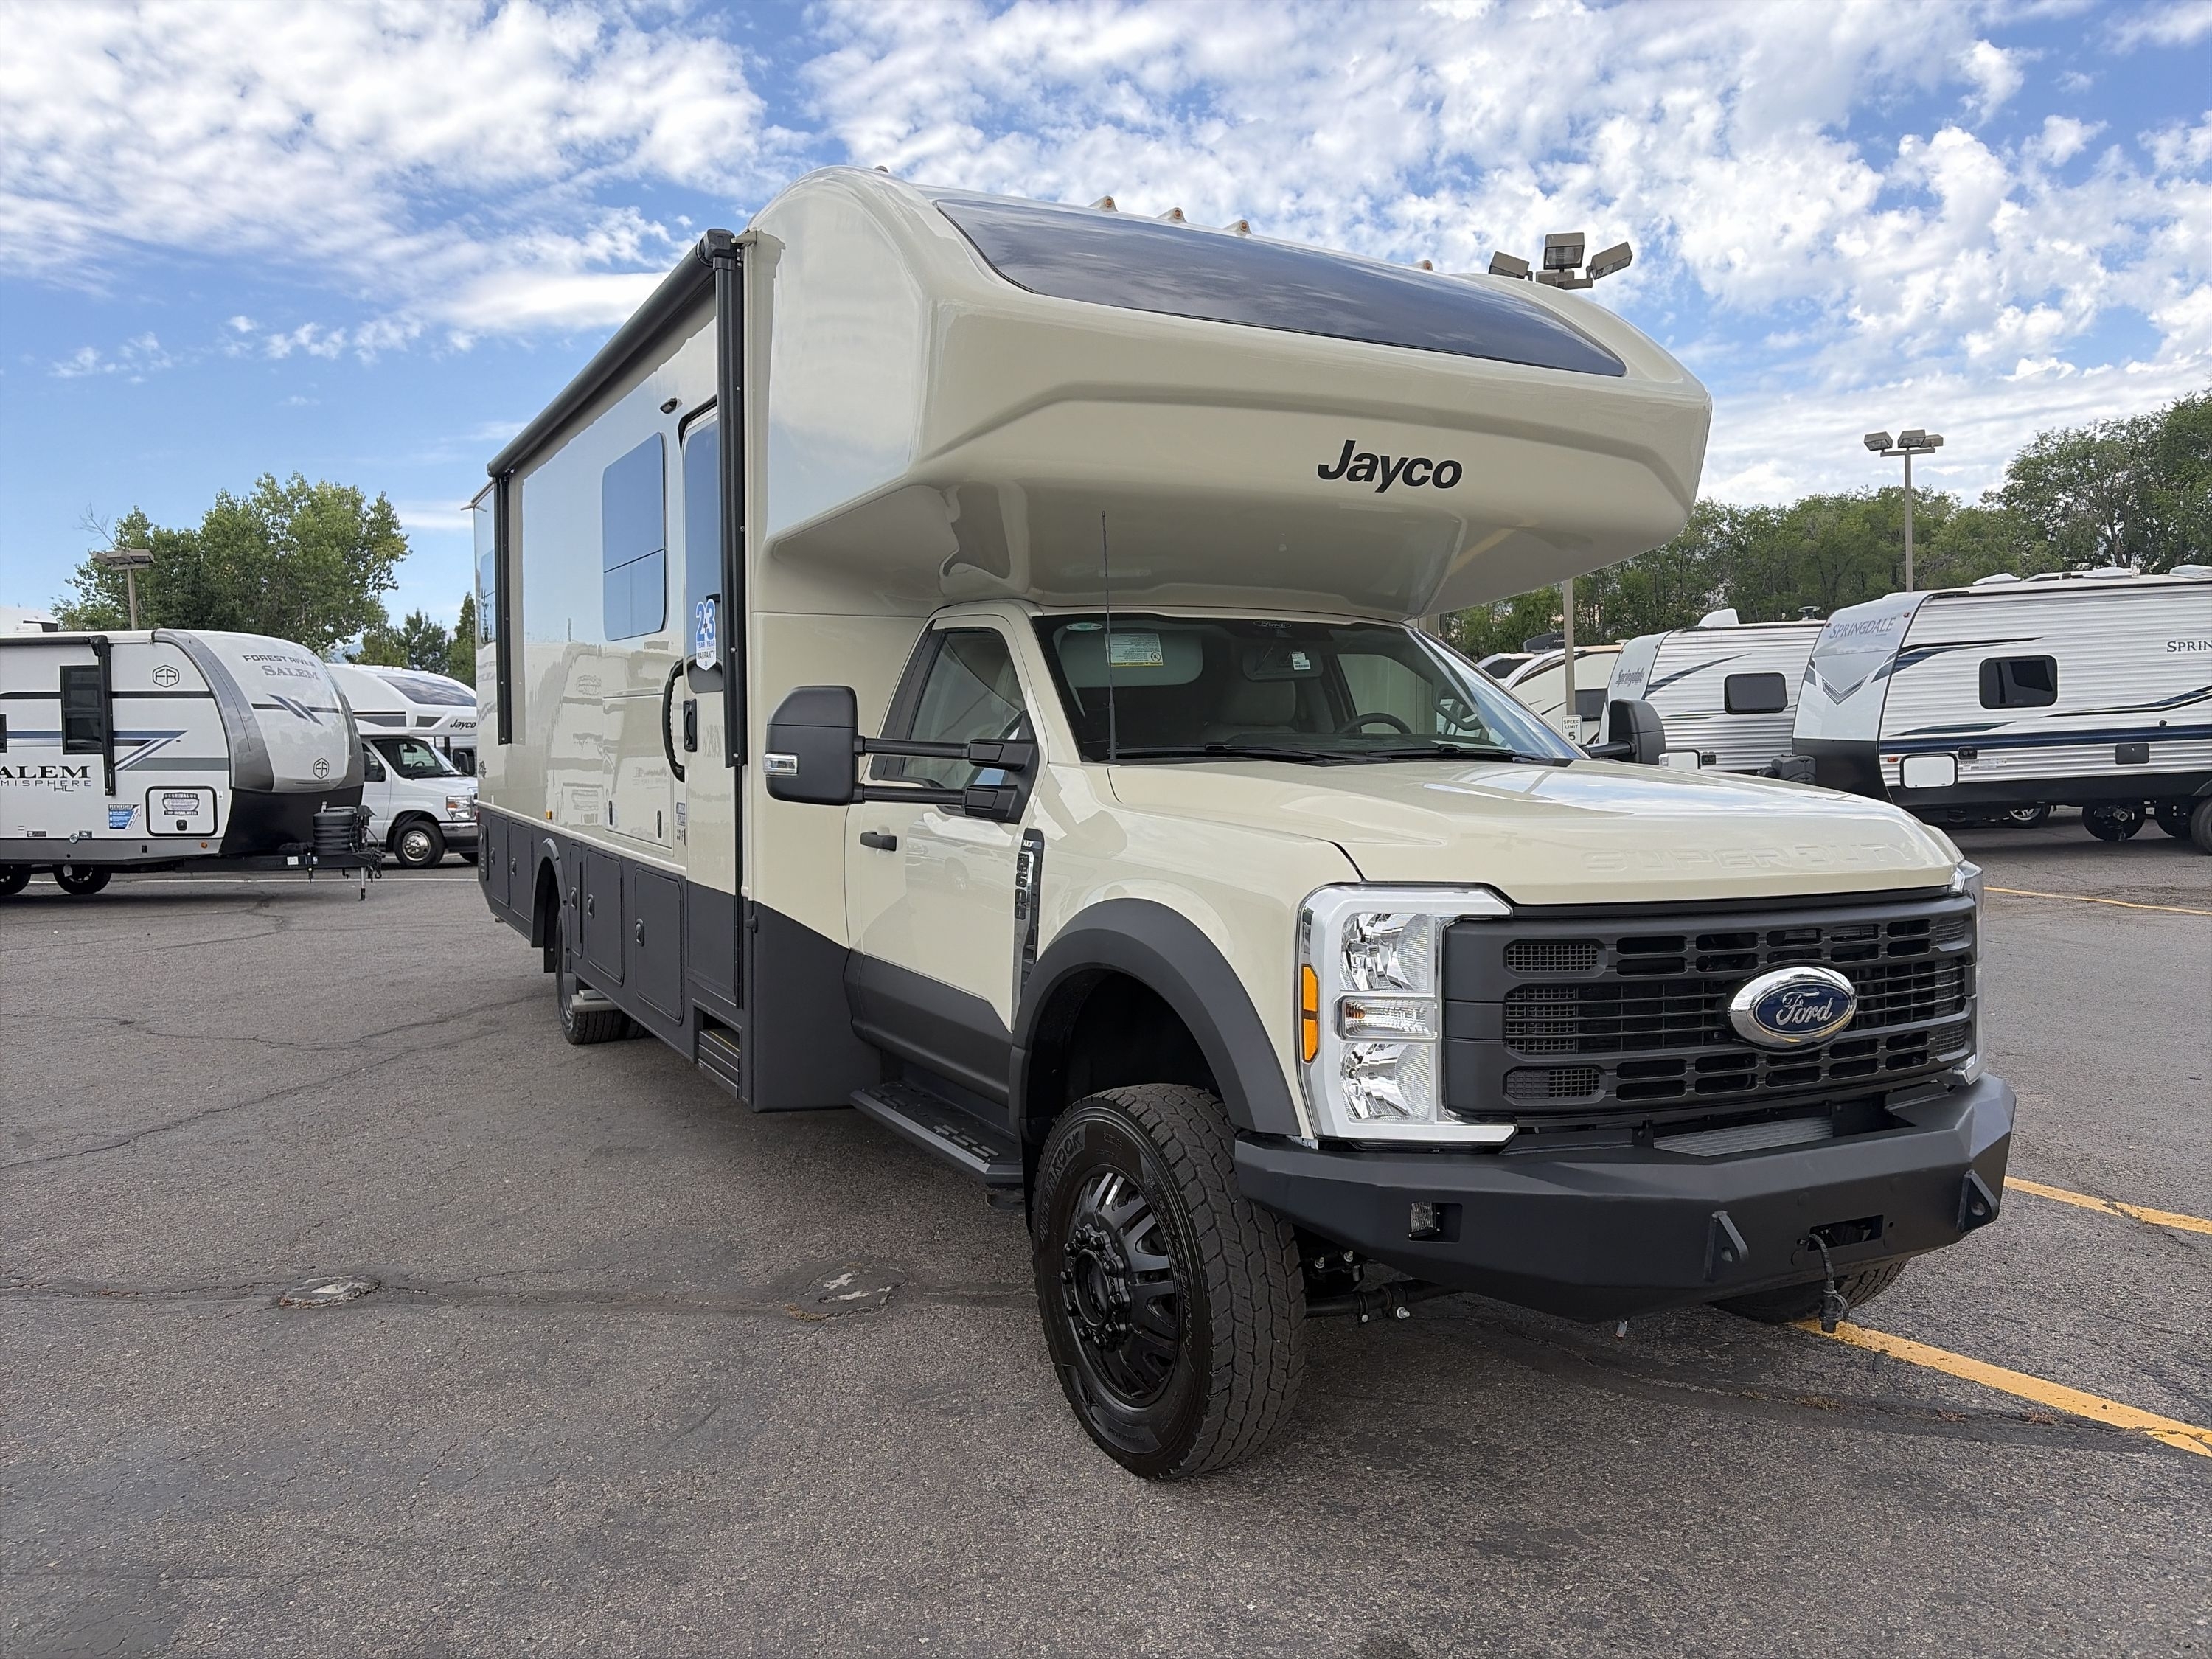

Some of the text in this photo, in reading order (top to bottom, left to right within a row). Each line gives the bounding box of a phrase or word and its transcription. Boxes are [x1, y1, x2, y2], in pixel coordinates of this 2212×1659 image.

[1317, 439, 1463, 493] Jayco
[1829, 617, 1896, 639] SPRINGDALE
[242, 654, 317, 668] FOREST RIVER
[697, 650, 715, 660] WARRANTY
[261, 665, 320, 680] SALEM
[449, 718, 477, 731] Jayco
[1568, 731, 1576, 741] 5
[0, 765, 91, 779] ALEM
[1023, 839, 1034, 848] XLT
[1581, 842, 1917, 872] SUPER DUTY
[1775, 991, 1834, 1026] Ford
